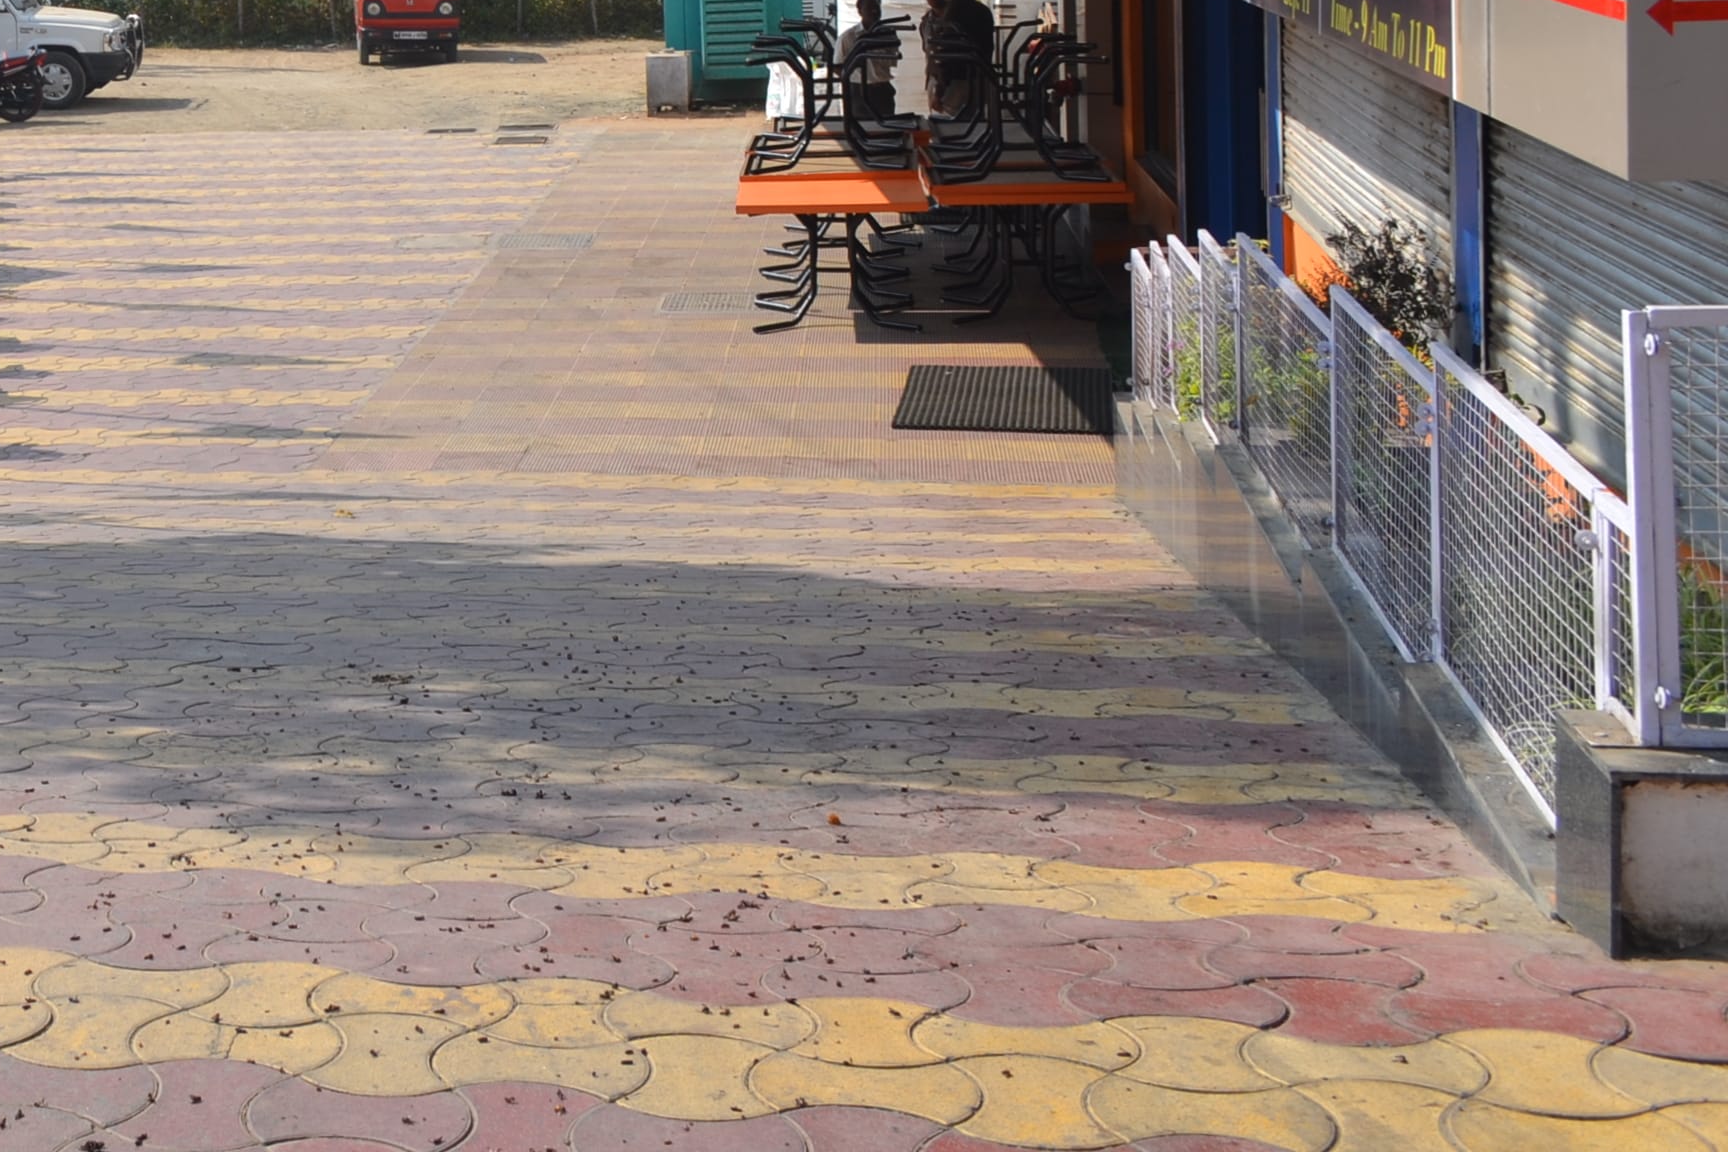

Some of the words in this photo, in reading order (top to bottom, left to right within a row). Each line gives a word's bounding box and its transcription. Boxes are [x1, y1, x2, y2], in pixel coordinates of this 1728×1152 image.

[1391, 12, 1406, 60] To
[1408, 19, 1422, 68] 11
[1424, 25, 1447, 80] Pm
